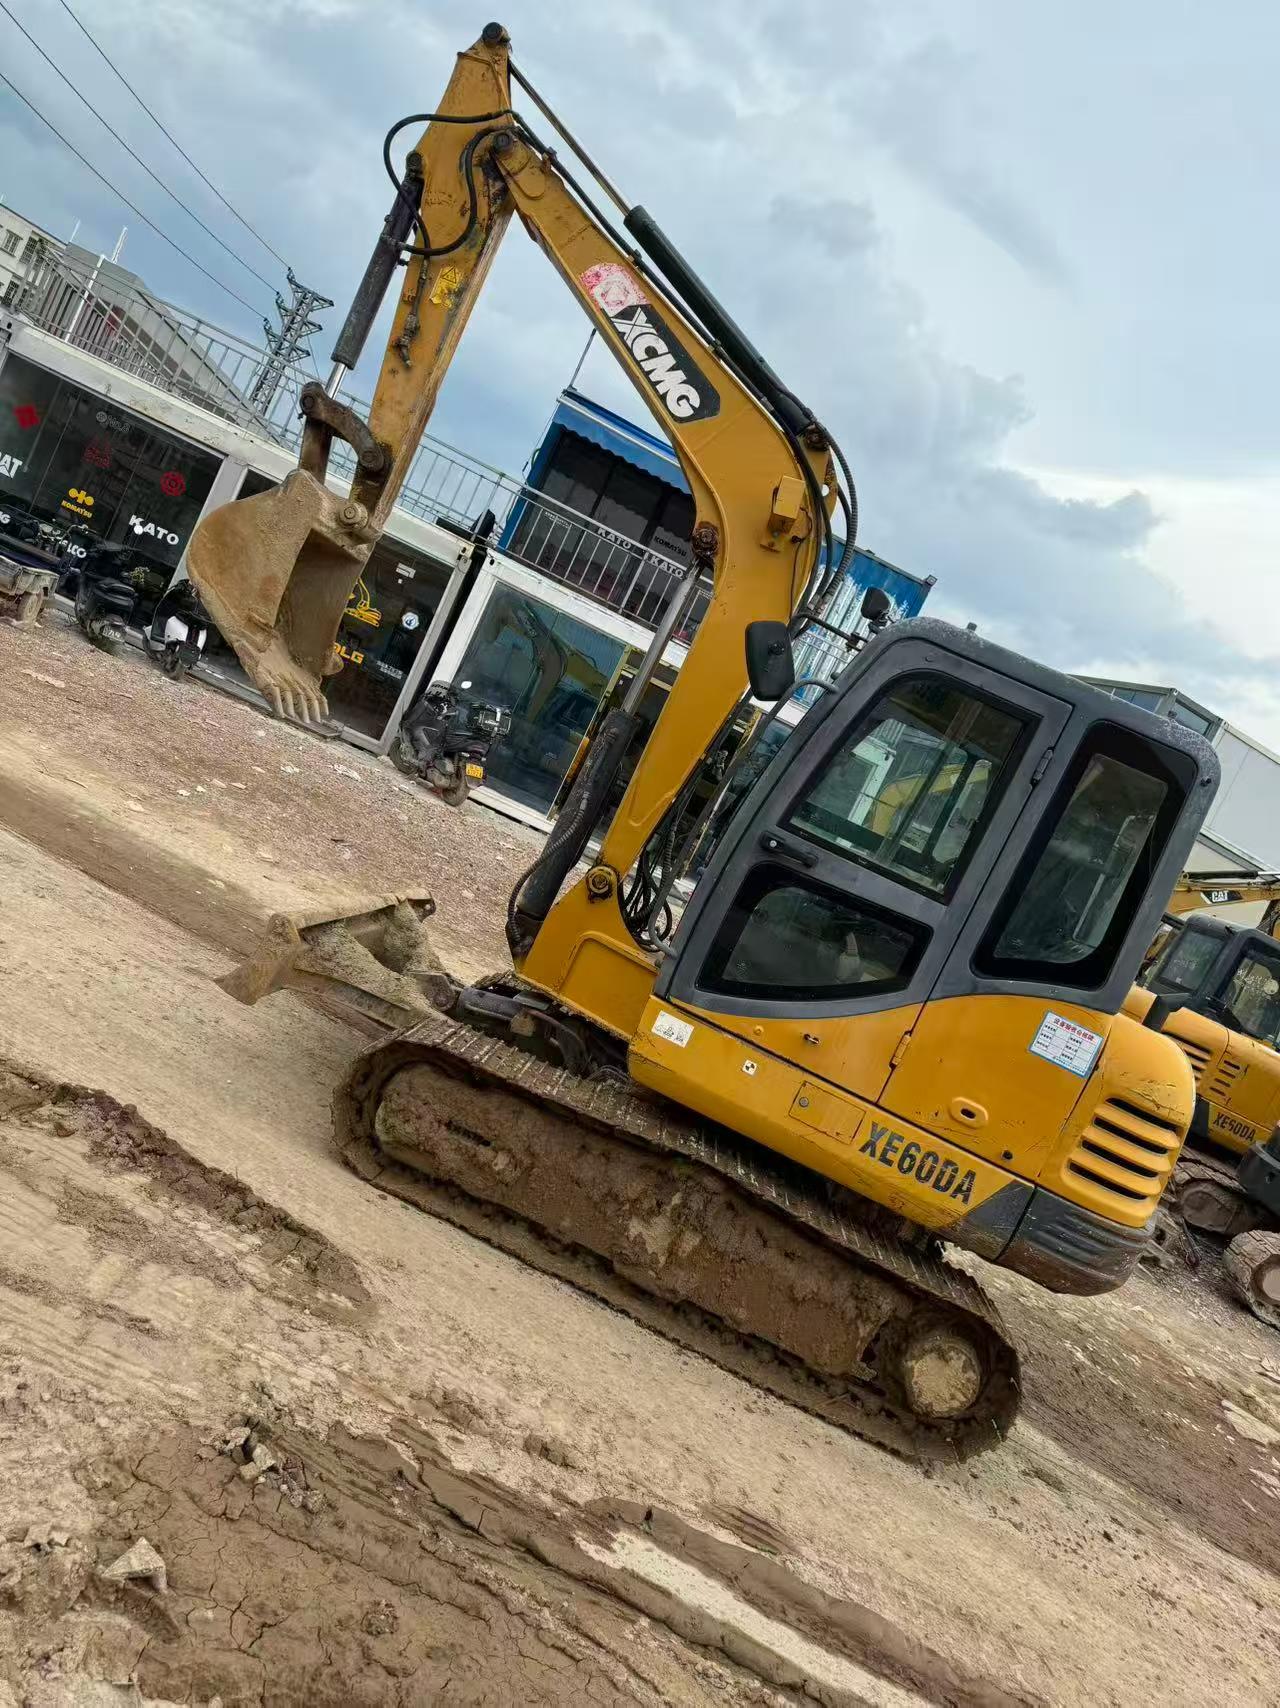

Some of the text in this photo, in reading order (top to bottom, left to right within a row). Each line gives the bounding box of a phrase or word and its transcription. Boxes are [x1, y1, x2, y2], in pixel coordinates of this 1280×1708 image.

[611, 307, 700, 418] XCMG
[0, 453, 22, 479] AT
[61, 499, 93, 518] KOMATSU
[129, 514, 180, 545] KATO
[597, 527, 632, 550] KATO
[654, 535, 687, 557] KOMATSU
[650, 555, 684, 579] KATO
[1211, 889, 1228, 902] CAT
[858, 1120, 977, 1205] XE60DA
